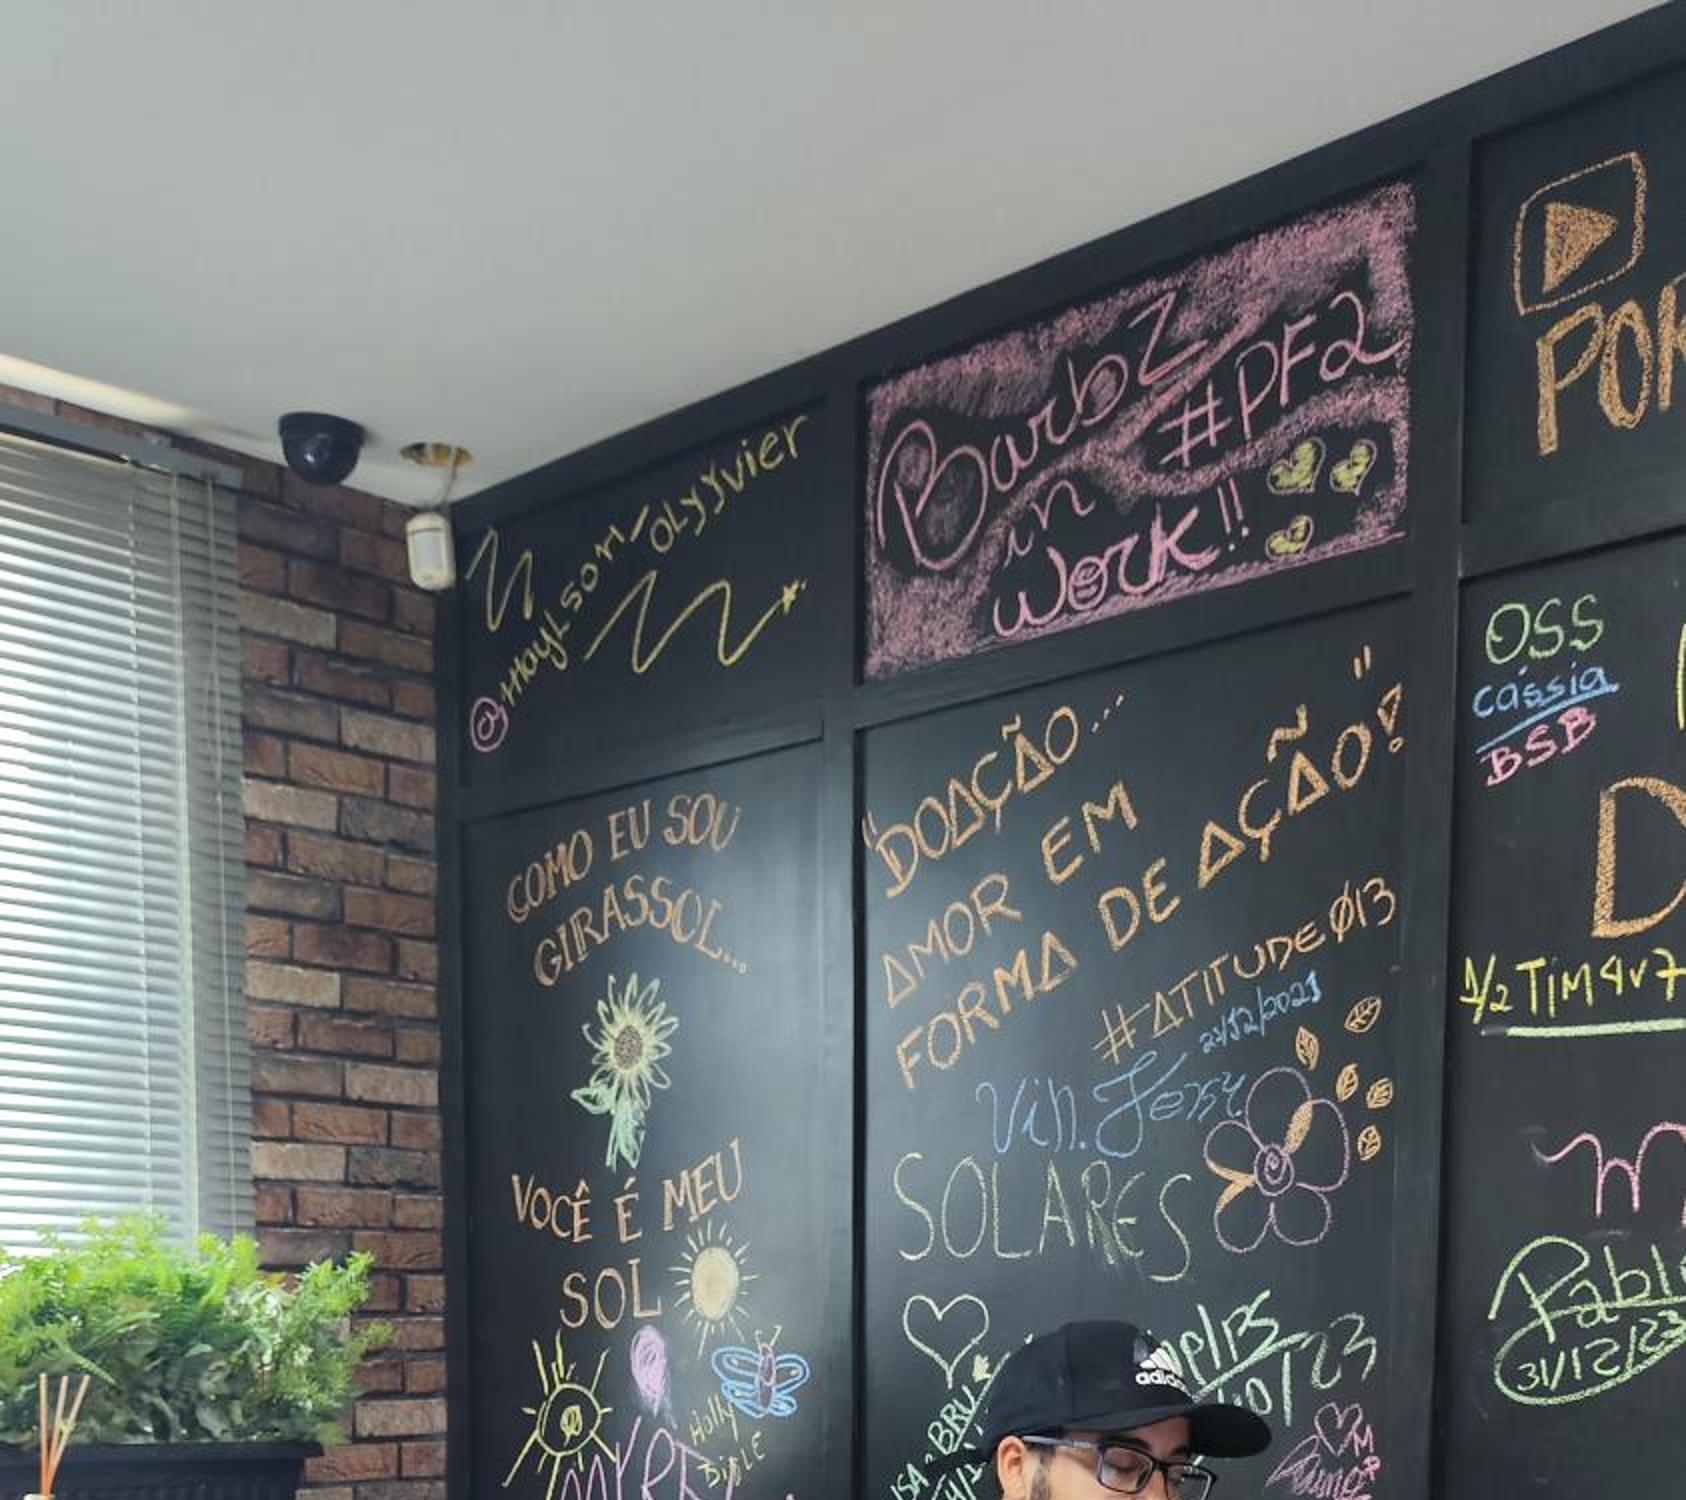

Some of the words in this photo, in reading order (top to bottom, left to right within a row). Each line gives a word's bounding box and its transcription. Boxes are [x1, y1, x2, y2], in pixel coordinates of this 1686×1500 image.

[1003, 480, 1096, 566] in
[1485, 593, 1603, 665] OSS
[1476, 705, 1598, 788] BSB
[506, 829, 594, 923] COMO
[607, 799, 651, 862] EU
[662, 793, 743, 852] SOU
[1040, 780, 1138, 884] EM
[897, 931, 1078, 1088] FORMA
[1098, 857, 1181, 951] DE
[511, 1173, 594, 1243] VOCÊ
[613, 1175, 643, 1244] É
[661, 1136, 744, 1231] MEU
[895, 1152, 1191, 1282] SOLARES
[559, 1257, 662, 1329] SOL
[1488, 1234, 1686, 1344] Pabl
